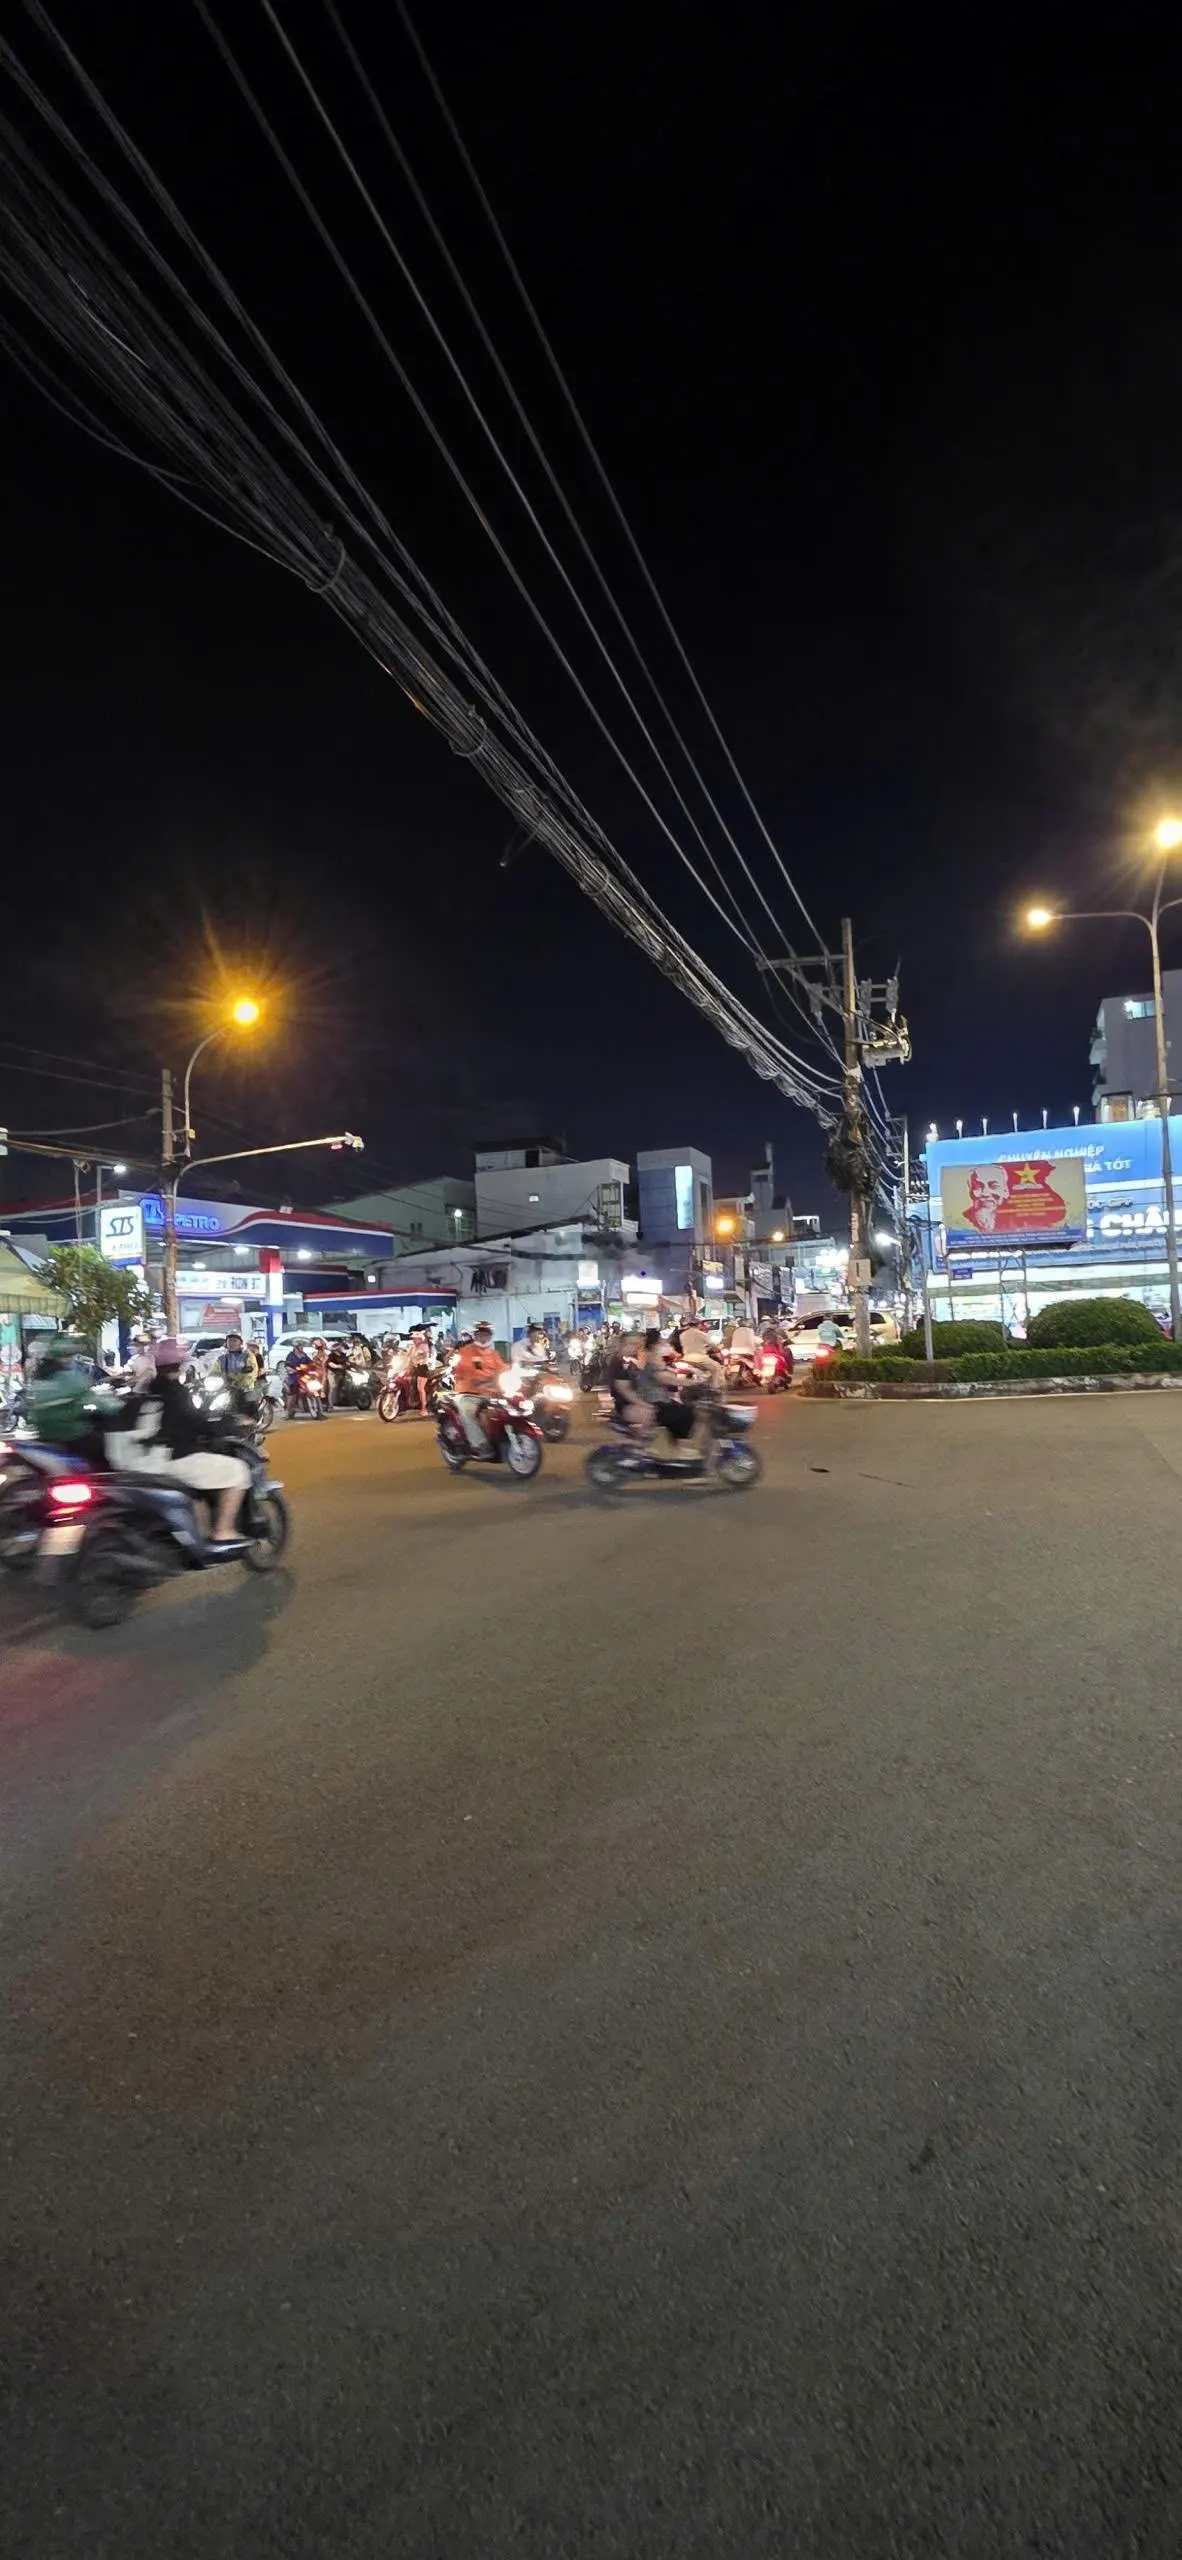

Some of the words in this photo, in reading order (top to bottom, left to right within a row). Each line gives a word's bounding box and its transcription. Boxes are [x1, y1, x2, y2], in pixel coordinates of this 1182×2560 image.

[1104, 1156, 1132, 1171] TỐT
[105, 1215, 136, 1237] STS
[175, 1213, 220, 1231] PETRO
